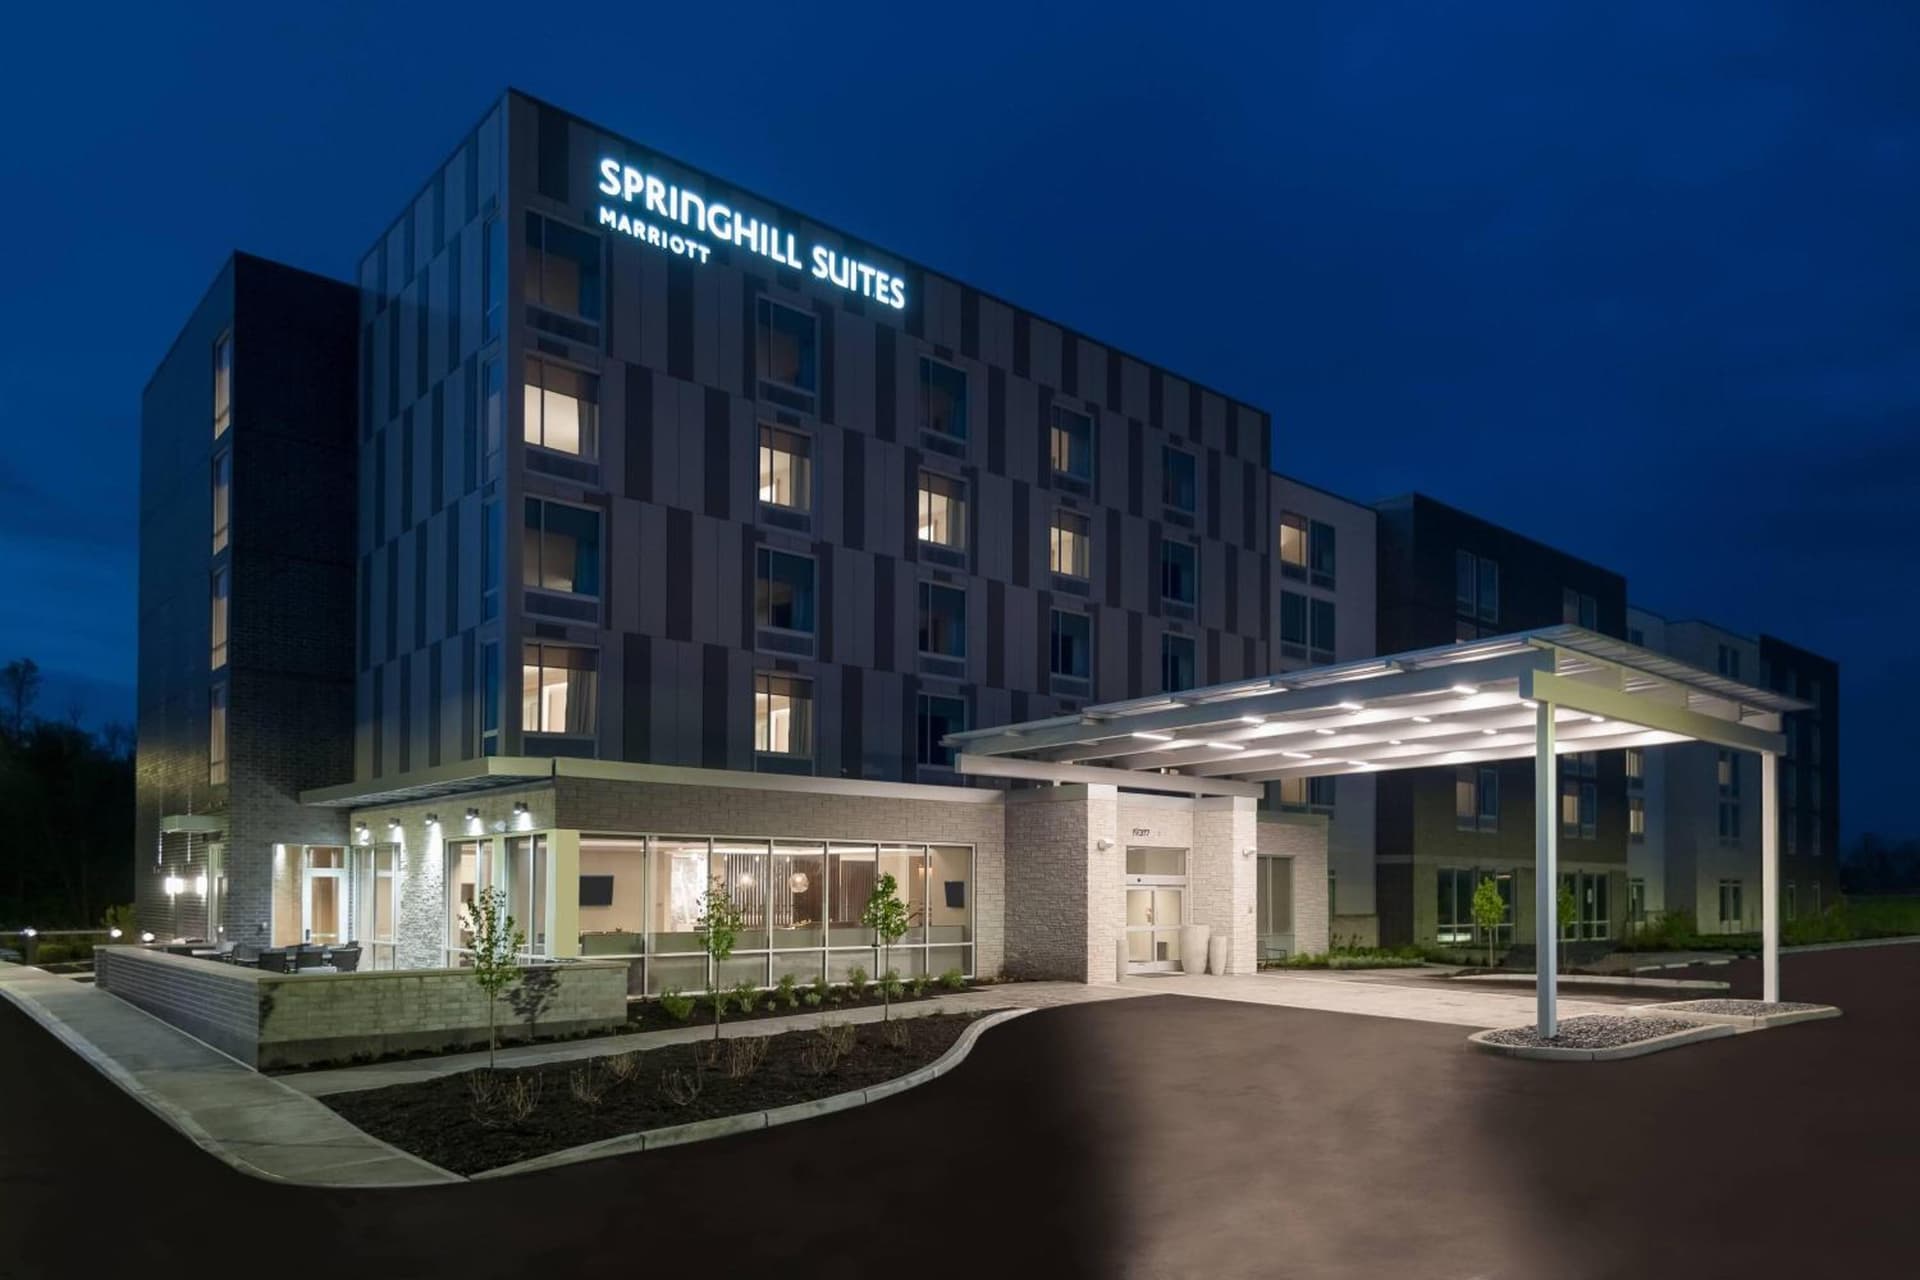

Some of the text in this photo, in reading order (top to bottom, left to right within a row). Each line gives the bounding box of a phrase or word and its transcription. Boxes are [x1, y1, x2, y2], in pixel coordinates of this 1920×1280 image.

[598, 157, 906, 310] SPRINGHILL SUITES
[598, 206, 712, 265] MARRIOTT
